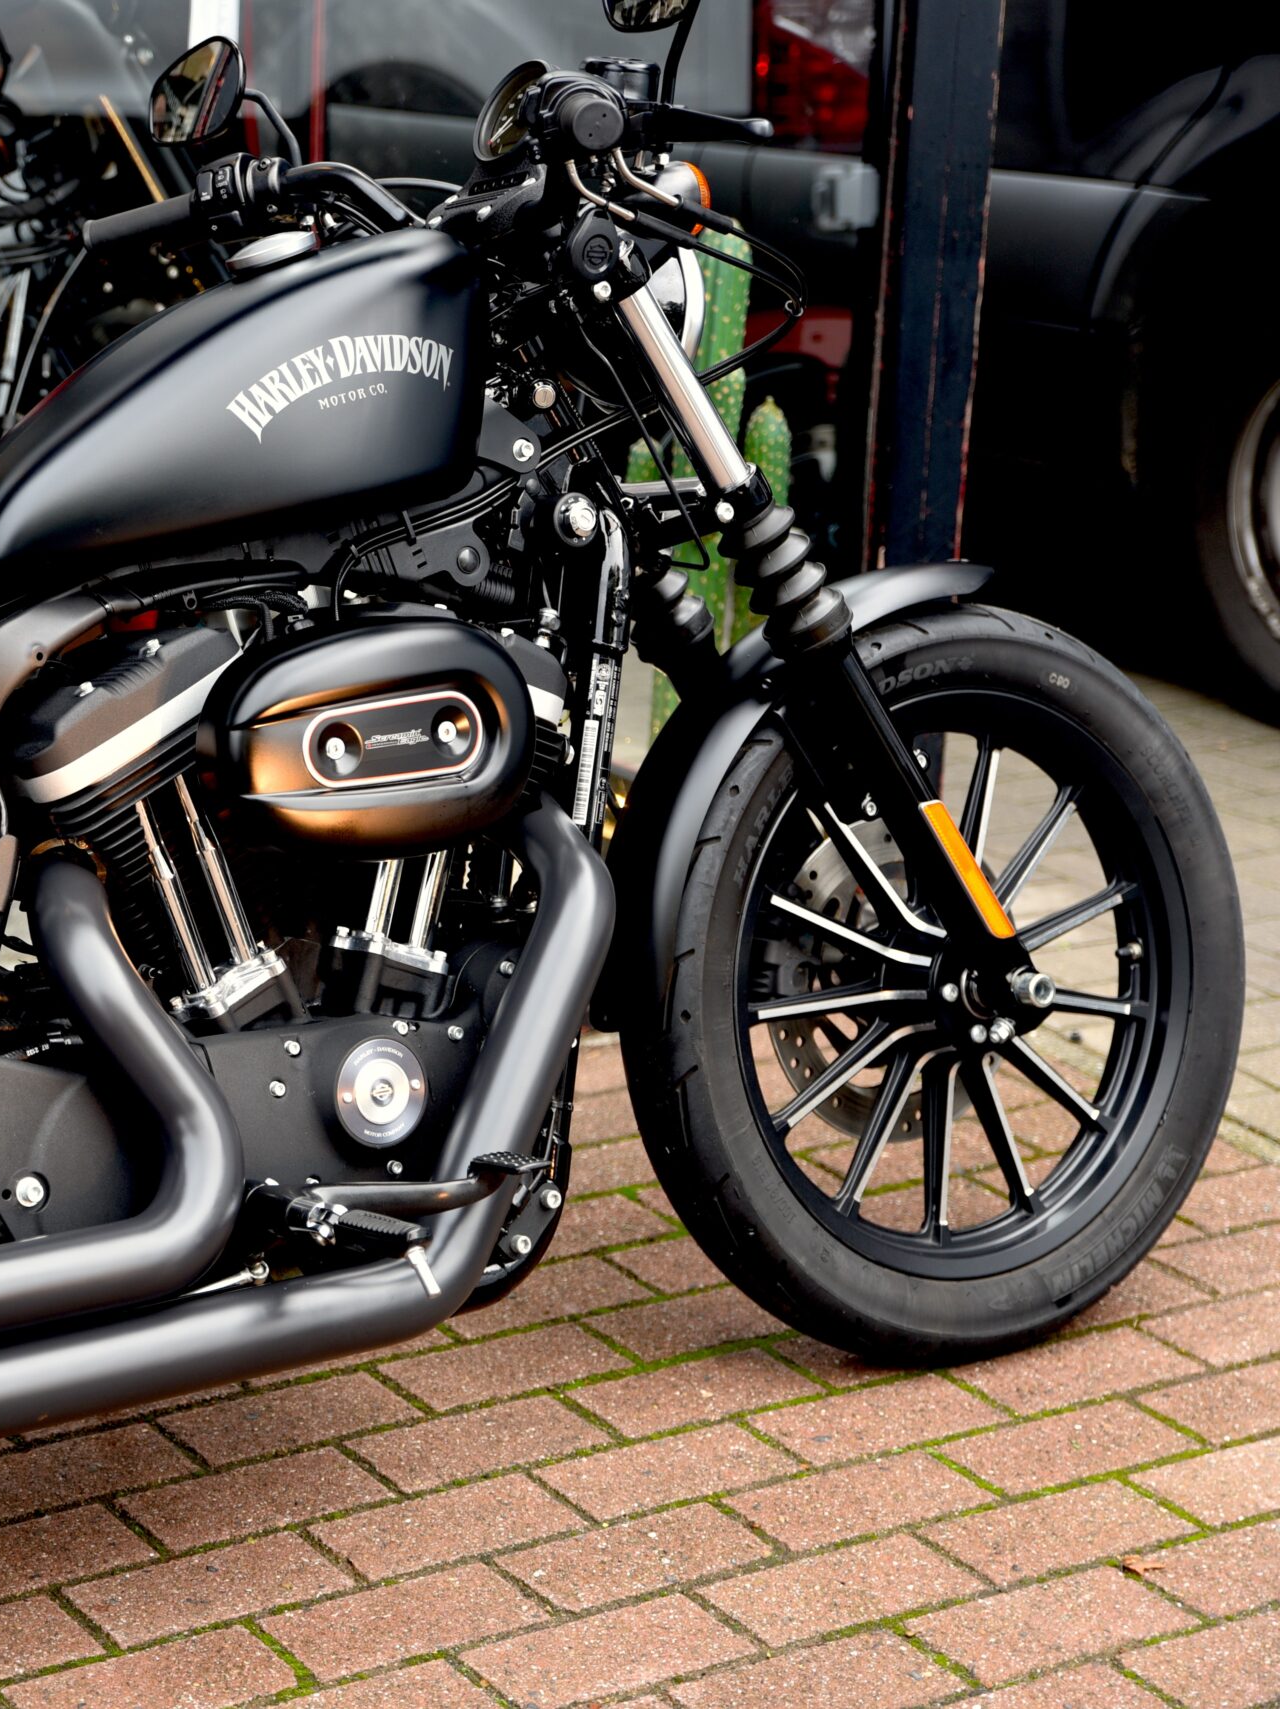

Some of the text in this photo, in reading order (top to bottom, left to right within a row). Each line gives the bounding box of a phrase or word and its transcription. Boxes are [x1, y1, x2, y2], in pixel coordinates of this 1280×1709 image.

[317, 383, 388, 410] MOTOR CO.
[363, 1122, 405, 1138] MOTOR COMPANY
[1050, 1181, 1164, 1296] MICHELIN
